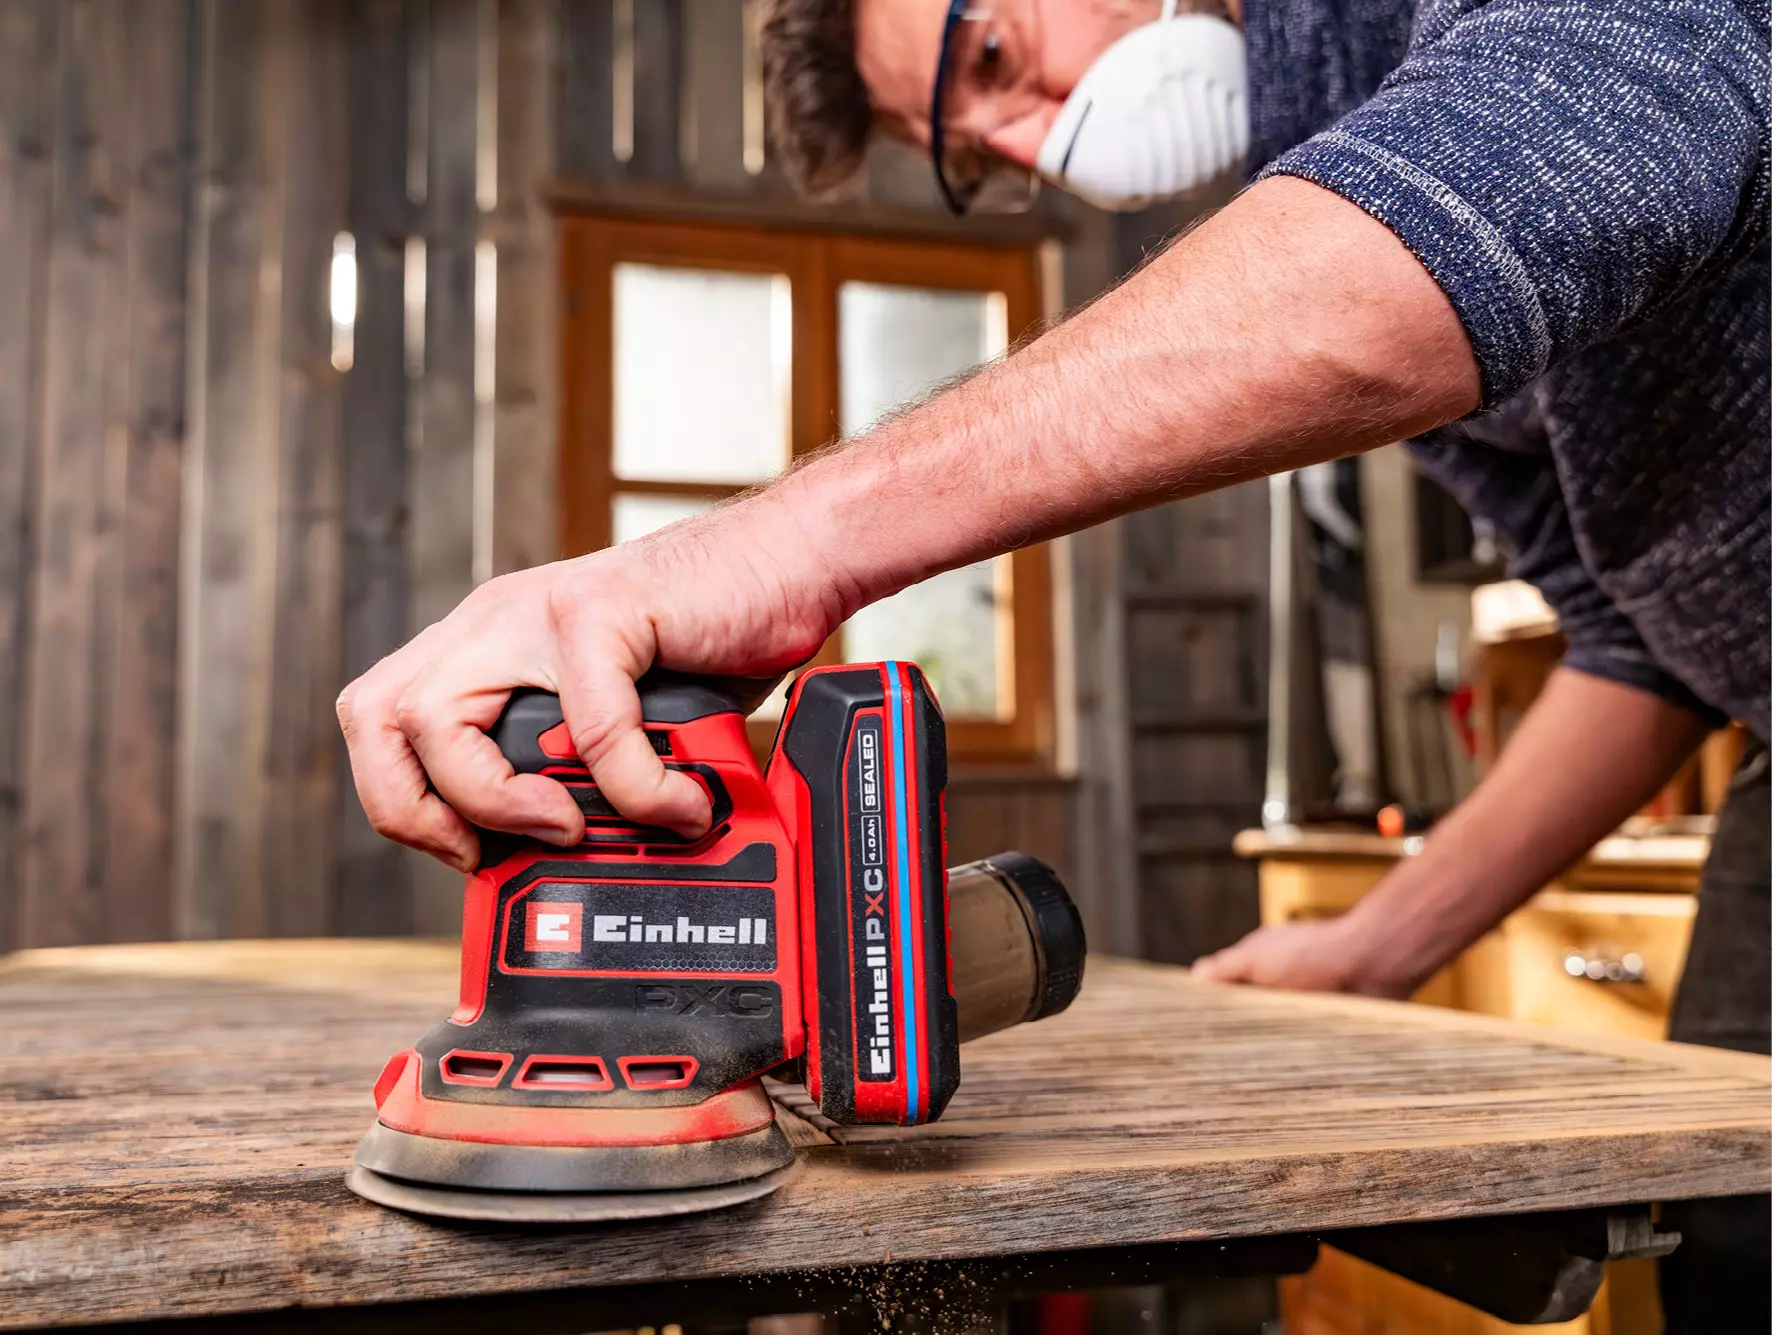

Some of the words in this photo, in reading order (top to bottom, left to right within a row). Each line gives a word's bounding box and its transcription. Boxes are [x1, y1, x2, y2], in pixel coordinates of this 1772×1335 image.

[863, 734, 877, 807] SEALED
[868, 818, 876, 861] 4.0Ah
[593, 915, 767, 945] Einhell
[863, 868, 886, 941] PXC
[634, 984, 773, 1019] PXC
[866, 945, 891, 1075] Einhell
